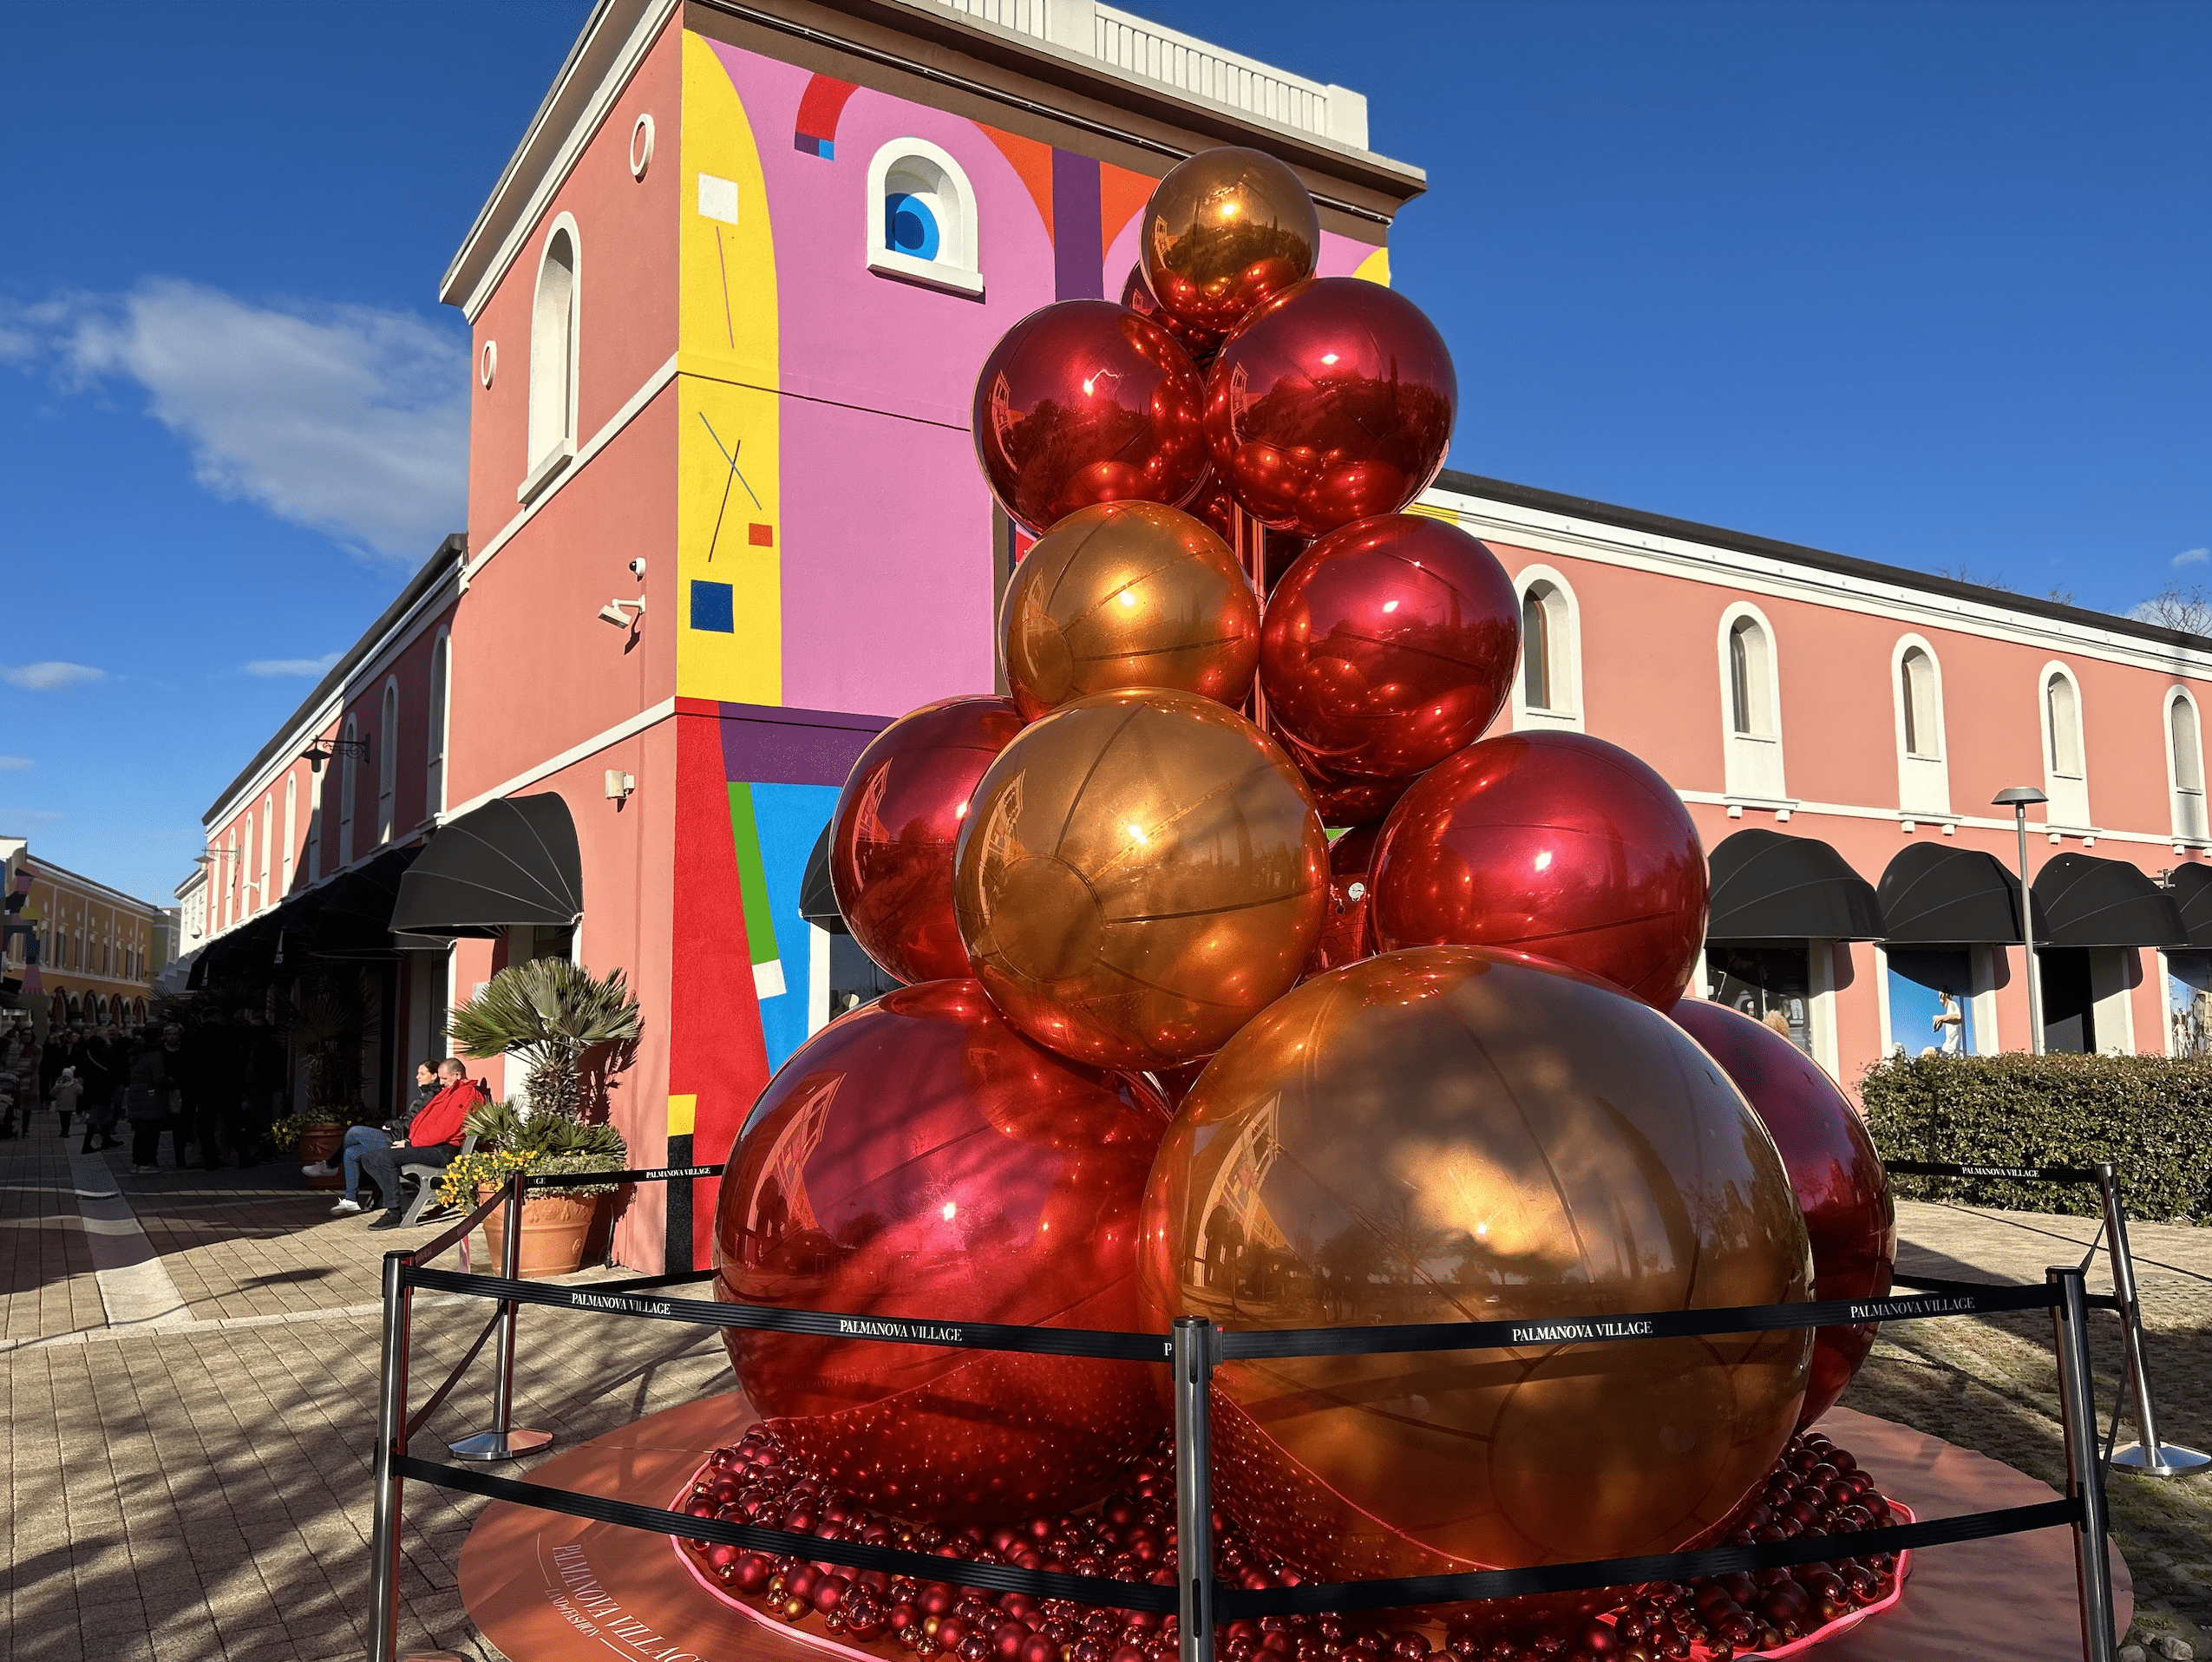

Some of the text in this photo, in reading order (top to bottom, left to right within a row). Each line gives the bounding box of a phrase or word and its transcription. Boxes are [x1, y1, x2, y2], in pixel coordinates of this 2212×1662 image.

[645, 1167, 711, 1179] PALMANOVA VILLAGE
[1962, 1167, 2040, 1178] PALMANOVA VILLAGE
[571, 1292, 671, 1315] PALMANOVA VILLAGE
[1850, 1297, 1975, 1318] PALMANOVA VILLAGE
[840, 1319, 963, 1342] PALMANOVA VILLAGE
[1512, 1320, 1653, 1342] PALMANOVA VILLAGE
[553, 1543, 622, 1619] PALMANOVA
